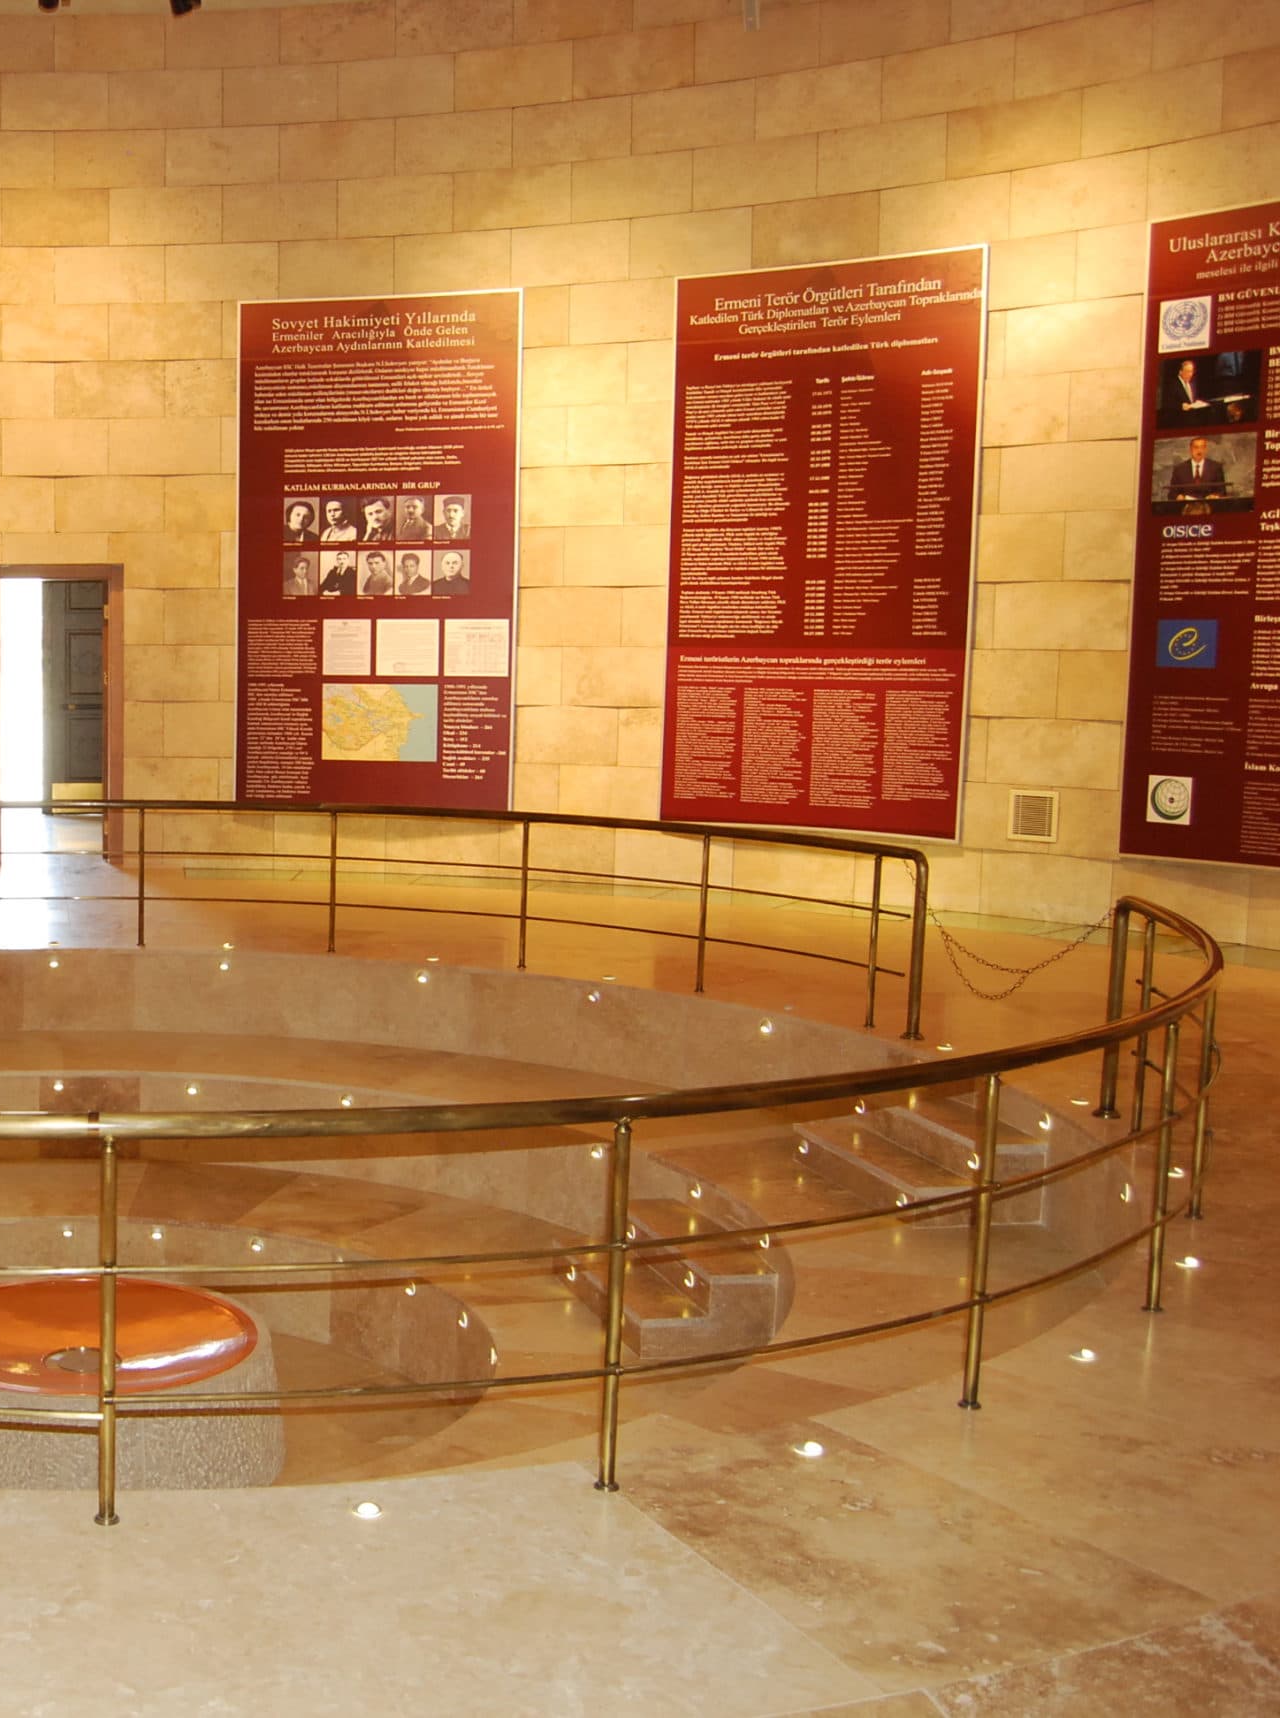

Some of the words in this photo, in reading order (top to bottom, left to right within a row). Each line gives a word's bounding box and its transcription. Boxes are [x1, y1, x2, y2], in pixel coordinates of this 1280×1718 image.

[1169, 228, 1262, 253] Uluslararası
[1196, 264, 1237, 280] meselesi
[1240, 263, 1252, 273] ile
[1254, 258, 1279, 273] ilgili
[715, 297, 761, 312] Ermeni
[765, 292, 799, 308] Terör
[803, 285, 863, 307] Örgütleri
[866, 278, 942, 297] Tarafından
[690, 312, 739, 326] Katledilen
[740, 310, 764, 322] Türk
[767, 304, 829, 321] Diplomatları
[832, 304, 845, 313] ve
[846, 298, 907, 314] Azerbaycan
[909, 289, 983, 306] Topraklarında
[272, 318, 319, 334] Sovyet
[323, 312, 400, 329] Hakimiyeti
[405, 310, 476, 325] Yıllarında
[272, 331, 324, 342] Ermeniler
[331, 329, 396, 341] Aracılığıyla
[403, 325, 433, 337] Önde
[436, 325, 469, 336] Gelen
[739, 318, 817, 335] Gerçekleştirilen
[821, 315, 849, 328] Terör
[851, 311, 901, 328] Eylemleri
[272, 342, 333, 355] Azerbaycan
[336, 340, 403, 354] Aydınlarının
[406, 335, 476, 350] Katledilmesi
[714, 352, 740, 361] Ermeni
[741, 351, 759, 360] terör
[760, 349, 792, 360] örgütleri
[792, 345, 831, 356] tarafından
[870, 340, 889, 350] Türk
[283, 483, 320, 492] KATLİAM
[321, 482, 398, 492] KURBANLARINDAN
[402, 481, 416, 490] BİR
[418, 481, 441, 490] GRUP
